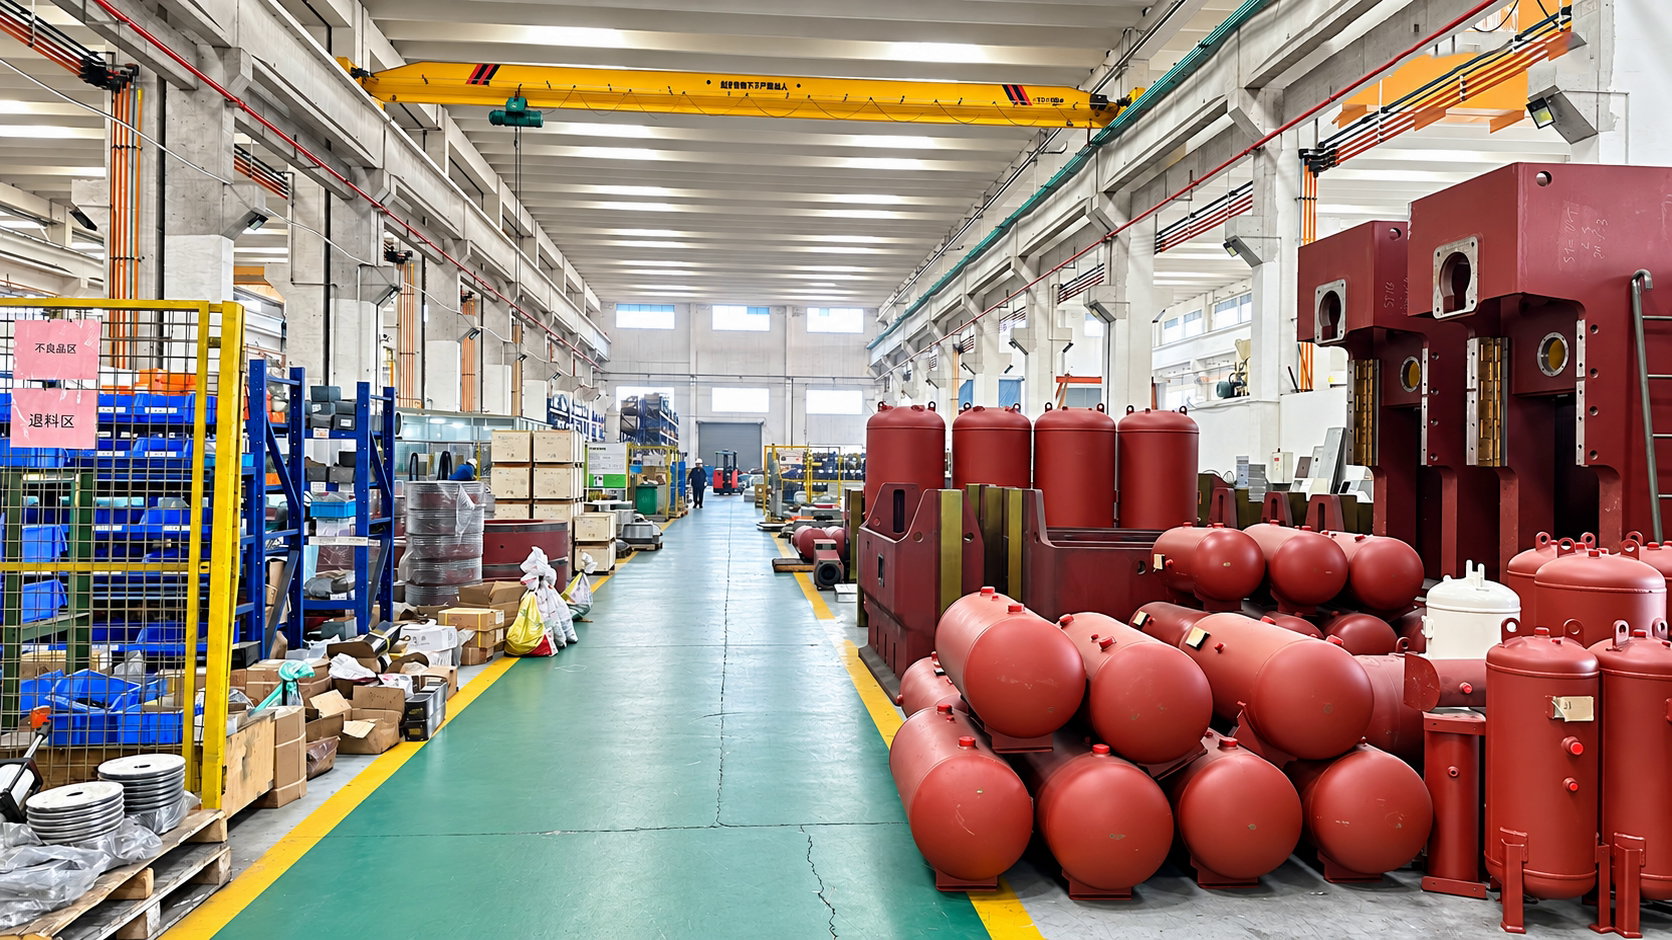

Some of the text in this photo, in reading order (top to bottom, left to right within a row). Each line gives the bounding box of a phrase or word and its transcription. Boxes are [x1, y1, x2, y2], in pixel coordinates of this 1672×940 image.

[35, 342, 77, 354] 不良品区
[28, 413, 75, 429] 退料区
